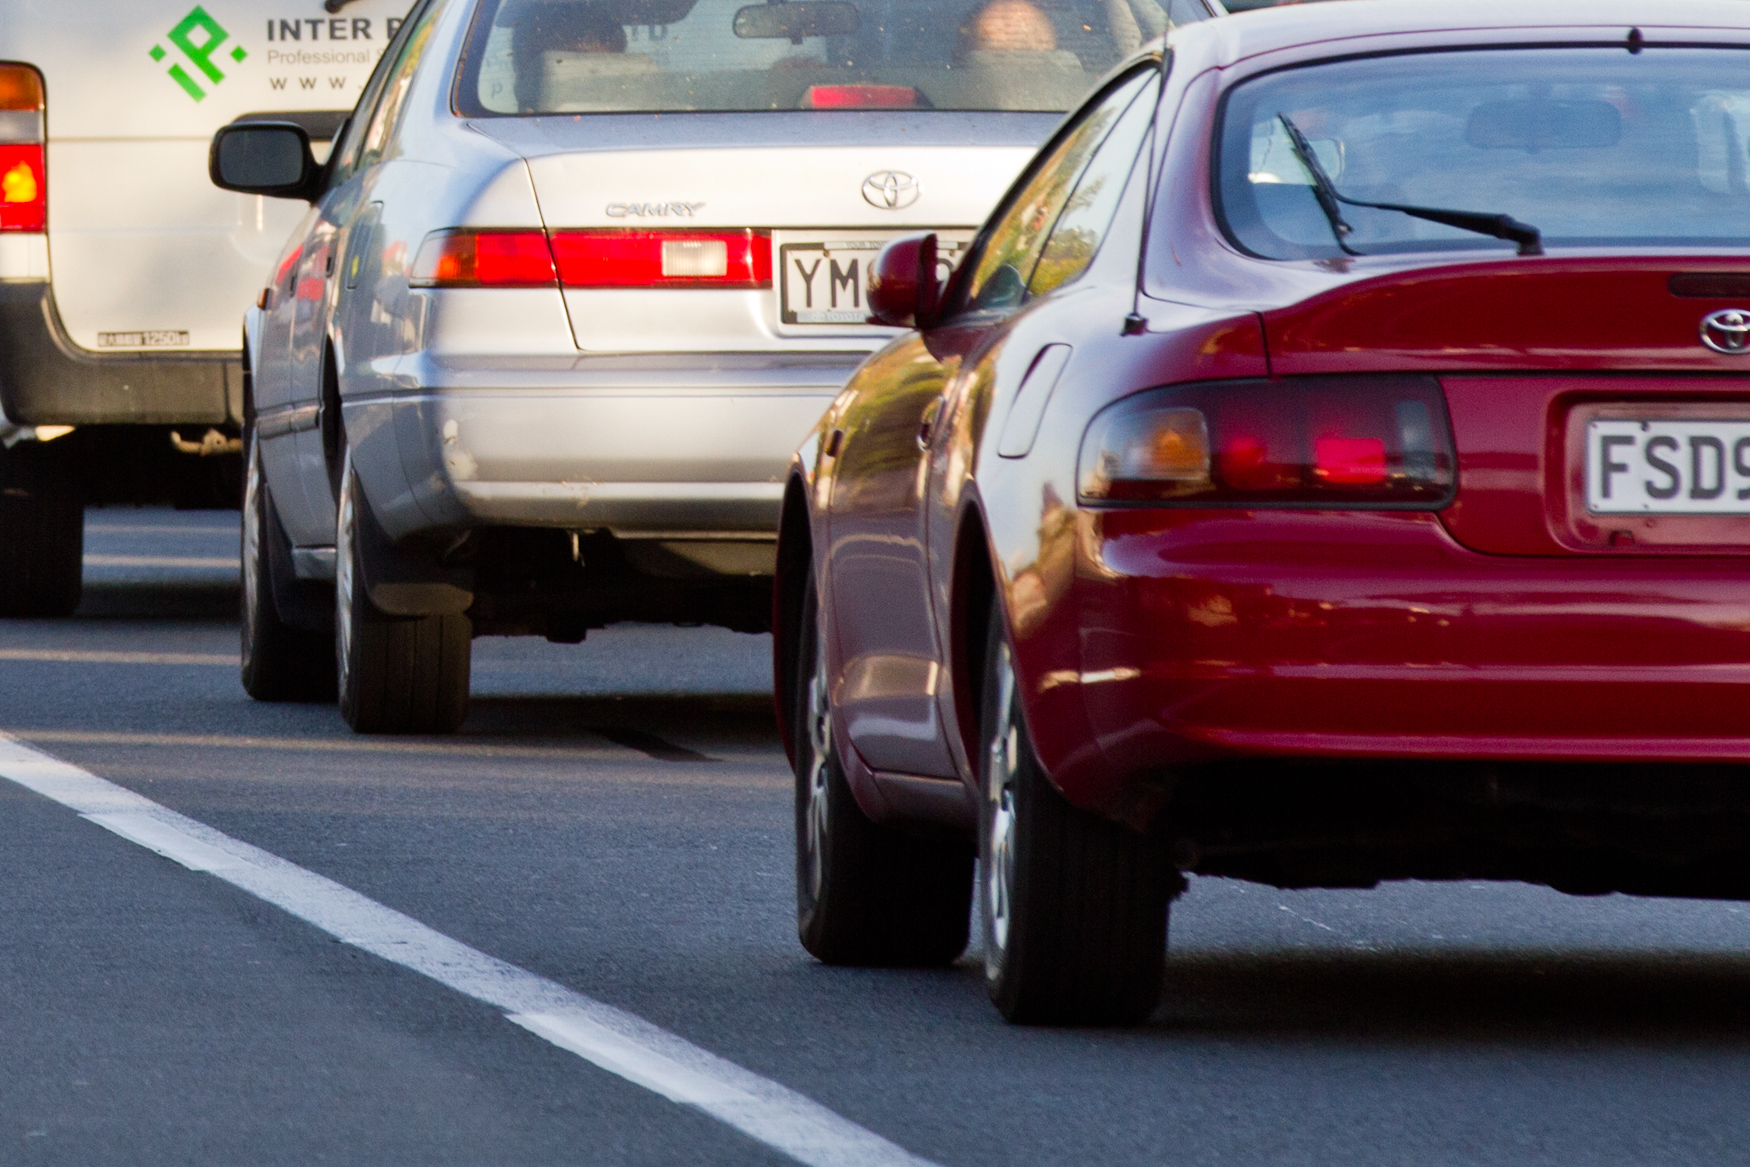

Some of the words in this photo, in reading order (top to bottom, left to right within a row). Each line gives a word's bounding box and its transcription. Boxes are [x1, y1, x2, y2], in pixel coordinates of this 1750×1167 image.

[267, 18, 374, 41] INTER
[267, 49, 371, 65] Professional
[605, 202, 706, 218] CAMRY
